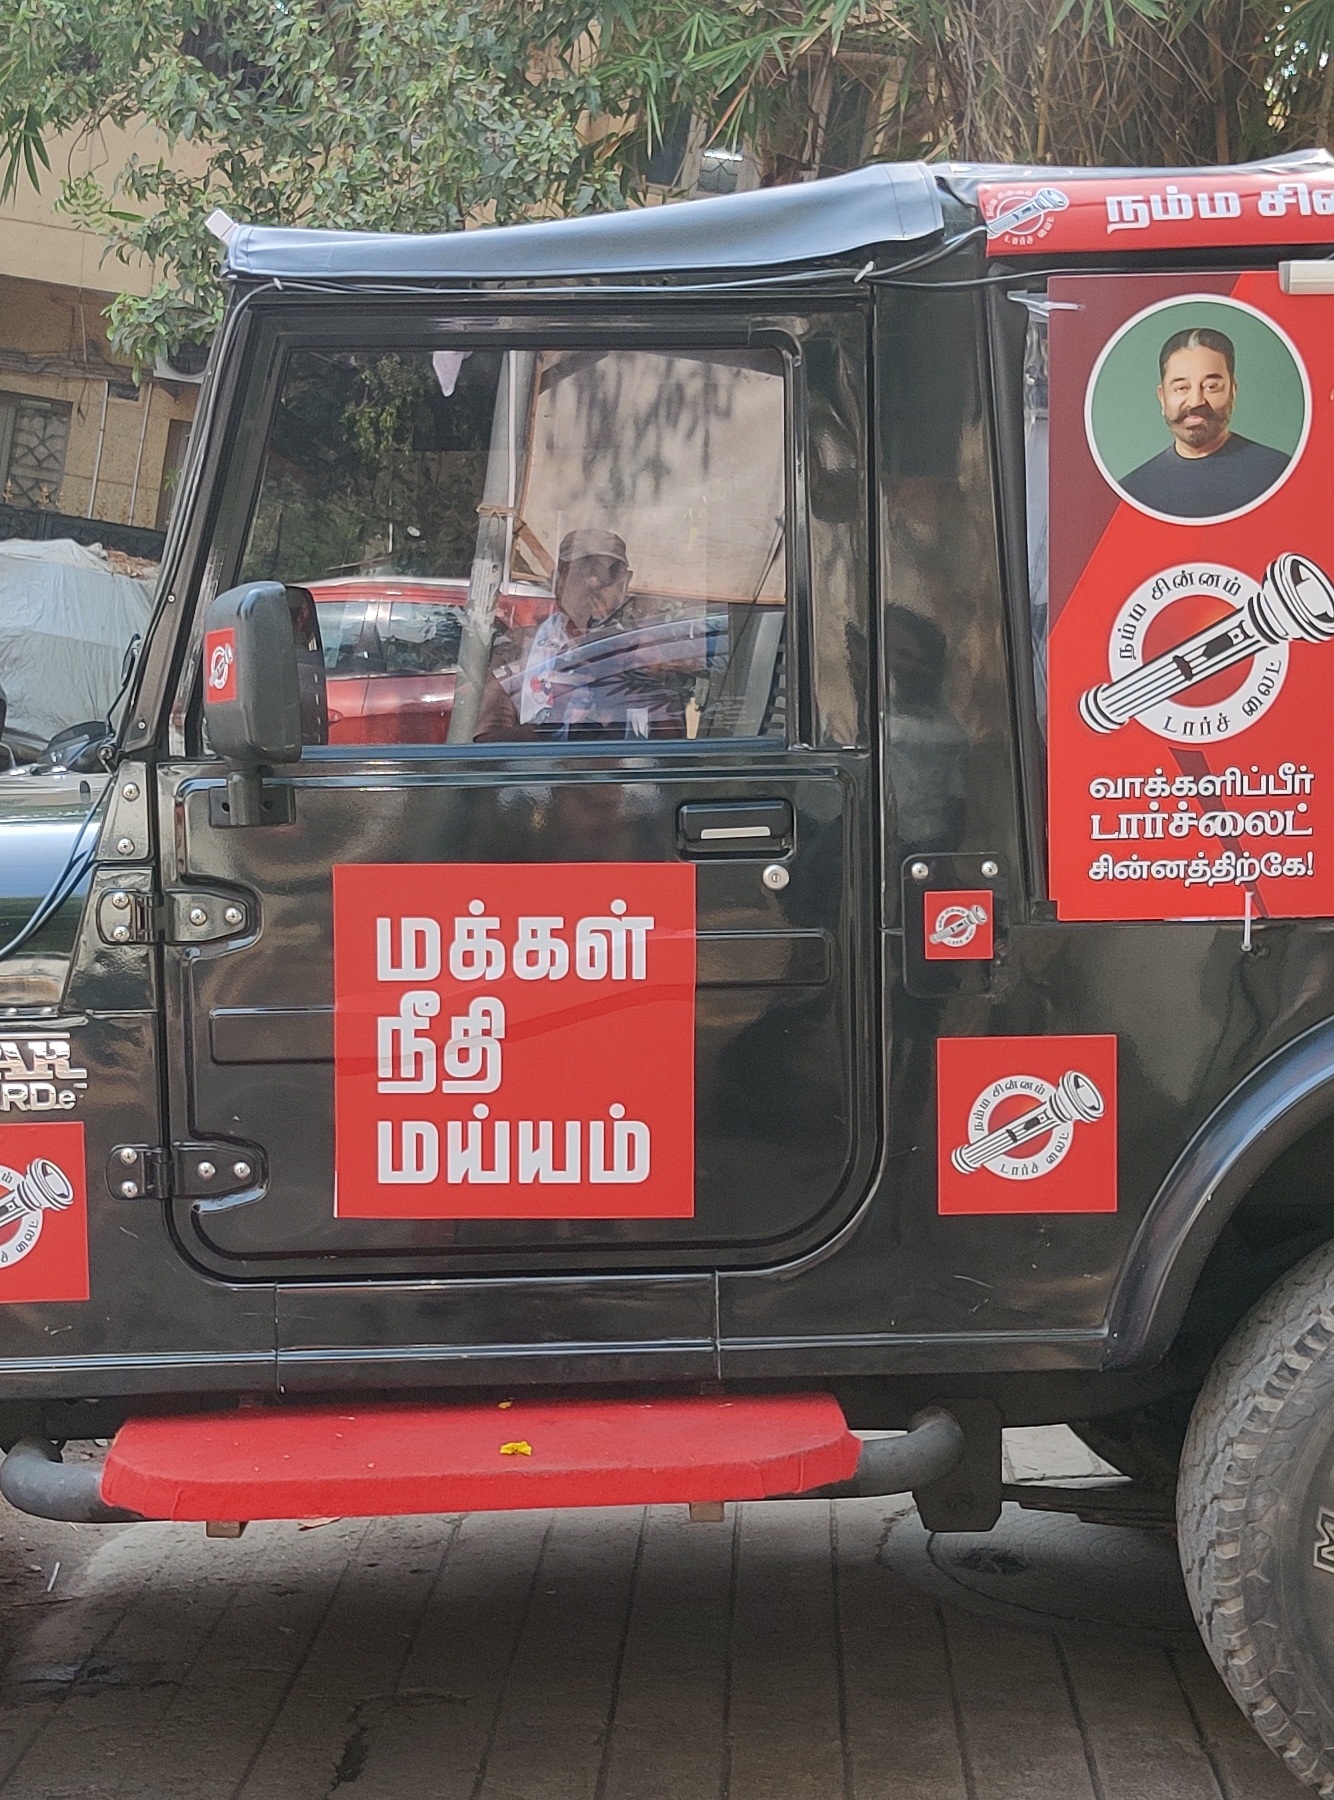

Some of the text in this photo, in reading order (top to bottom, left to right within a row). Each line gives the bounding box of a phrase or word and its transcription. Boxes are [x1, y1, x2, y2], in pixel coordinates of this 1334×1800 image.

[1106, 185, 1240, 236] நம்ம
[1118, 569, 1243, 661] நம்ம சின்னம்
[1162, 659, 1282, 737] டார்ச் லைட்
[1089, 762, 1315, 799] வாக்களிப்பீர்
[1090, 801, 1314, 840] டார்ச்லைட்
[1088, 851, 1315, 888] சின்னத்திற்கே!
[376, 898, 655, 981] மக்கள்
[377, 990, 506, 1094] நீதி
[377, 1103, 651, 1185] மய்யம்
